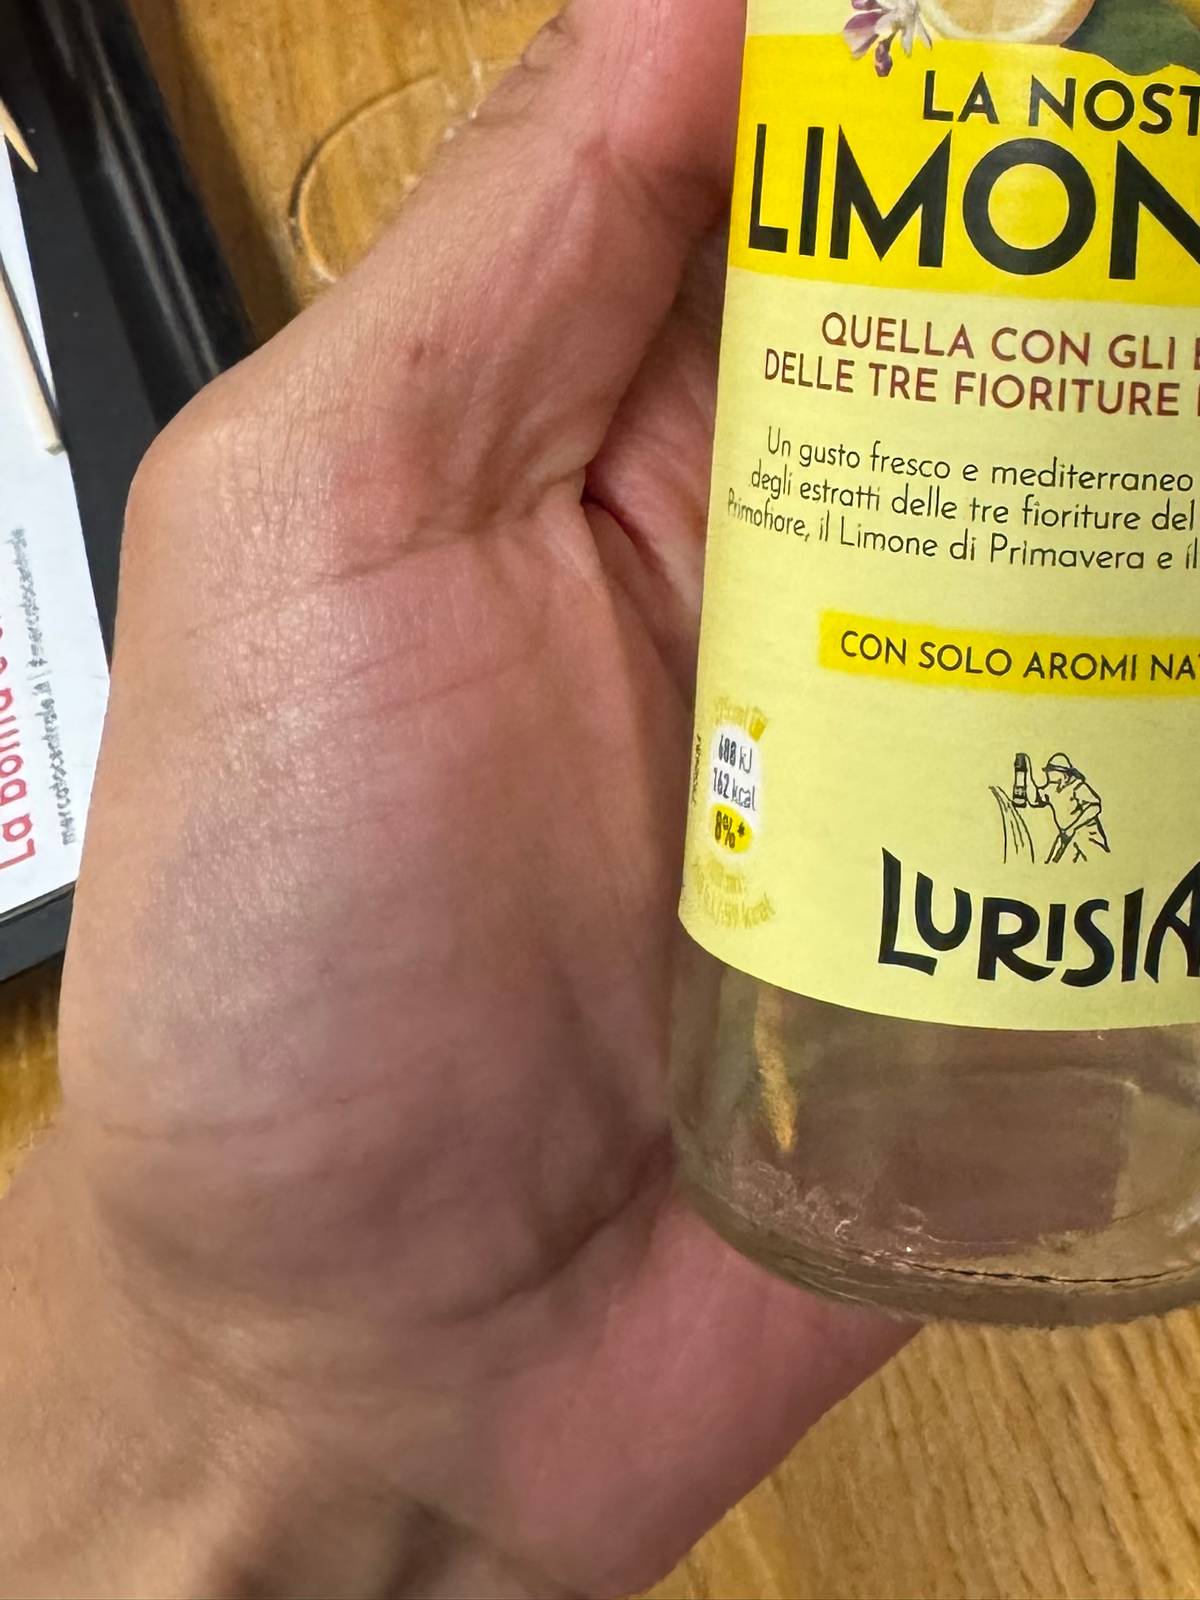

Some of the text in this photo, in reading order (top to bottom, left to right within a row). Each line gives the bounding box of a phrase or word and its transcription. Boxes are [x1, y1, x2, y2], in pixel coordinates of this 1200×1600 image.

[923, 69, 999, 123] LA
[821, 311, 974, 360] QUELLA
[991, 327, 1091, 368] CON
[1108, 334, 1176, 371] GLI
[765, 348, 853, 395] DELLE
[869, 363, 936, 403] TRE
[954, 371, 1178, 417] FIORITURE
[767, 426, 791, 456] Un
[799, 441, 861, 468] gusto
[870, 440, 951, 480] fresco
[962, 463, 979, 481] e
[991, 456, 1193, 492] mediterraneo
[750, 460, 792, 500] degli
[799, 479, 881, 511] estratti
[891, 483, 957, 520] delle
[969, 498, 1009, 524] tre
[1022, 494, 1141, 530] fioriture
[1151, 498, 1195, 531] del
[819, 510, 830, 541] il
[840, 516, 938, 557] Limone
[949, 528, 975, 561] di
[990, 533, 1145, 569] Primavera
[1156, 549, 1173, 570] e
[1185, 536, 1198, 570] il
[840, 630, 907, 666] CON
[918, 641, 1013, 678] SOLO
[1022, 648, 1137, 683] AROMI
[731, 777, 757, 811] kcal
[0, 812, 36, 870] La
